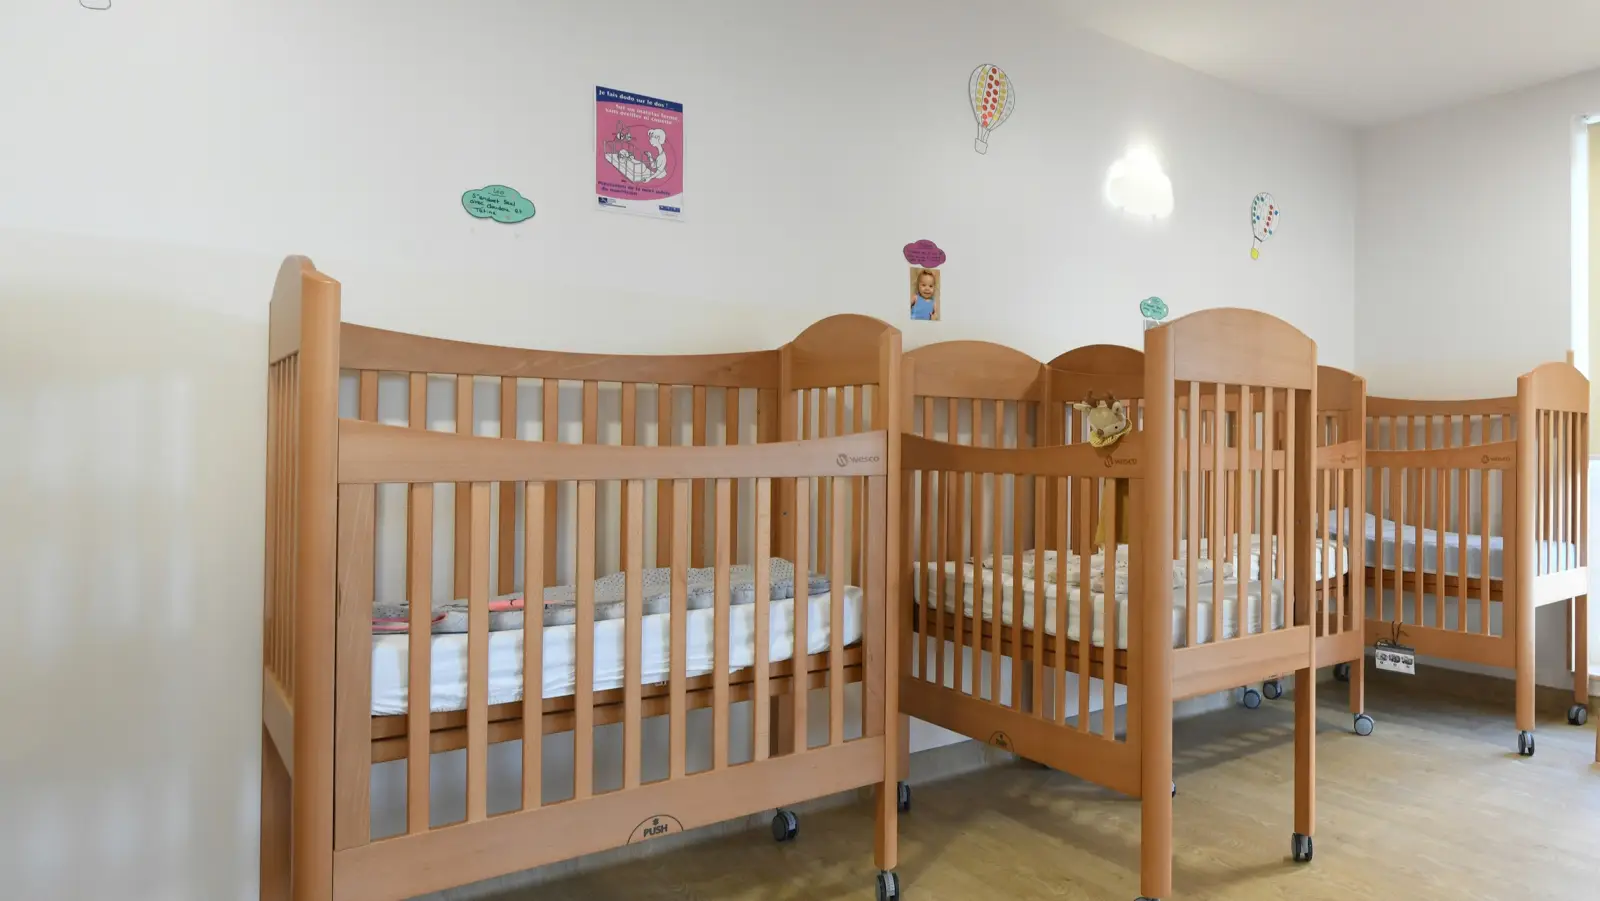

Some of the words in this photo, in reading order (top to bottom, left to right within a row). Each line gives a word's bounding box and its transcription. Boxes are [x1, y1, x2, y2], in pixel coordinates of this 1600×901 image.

[606, 90, 618, 98] fais
[619, 93, 635, 102] dodo
[644, 823, 668, 838] PUSH
